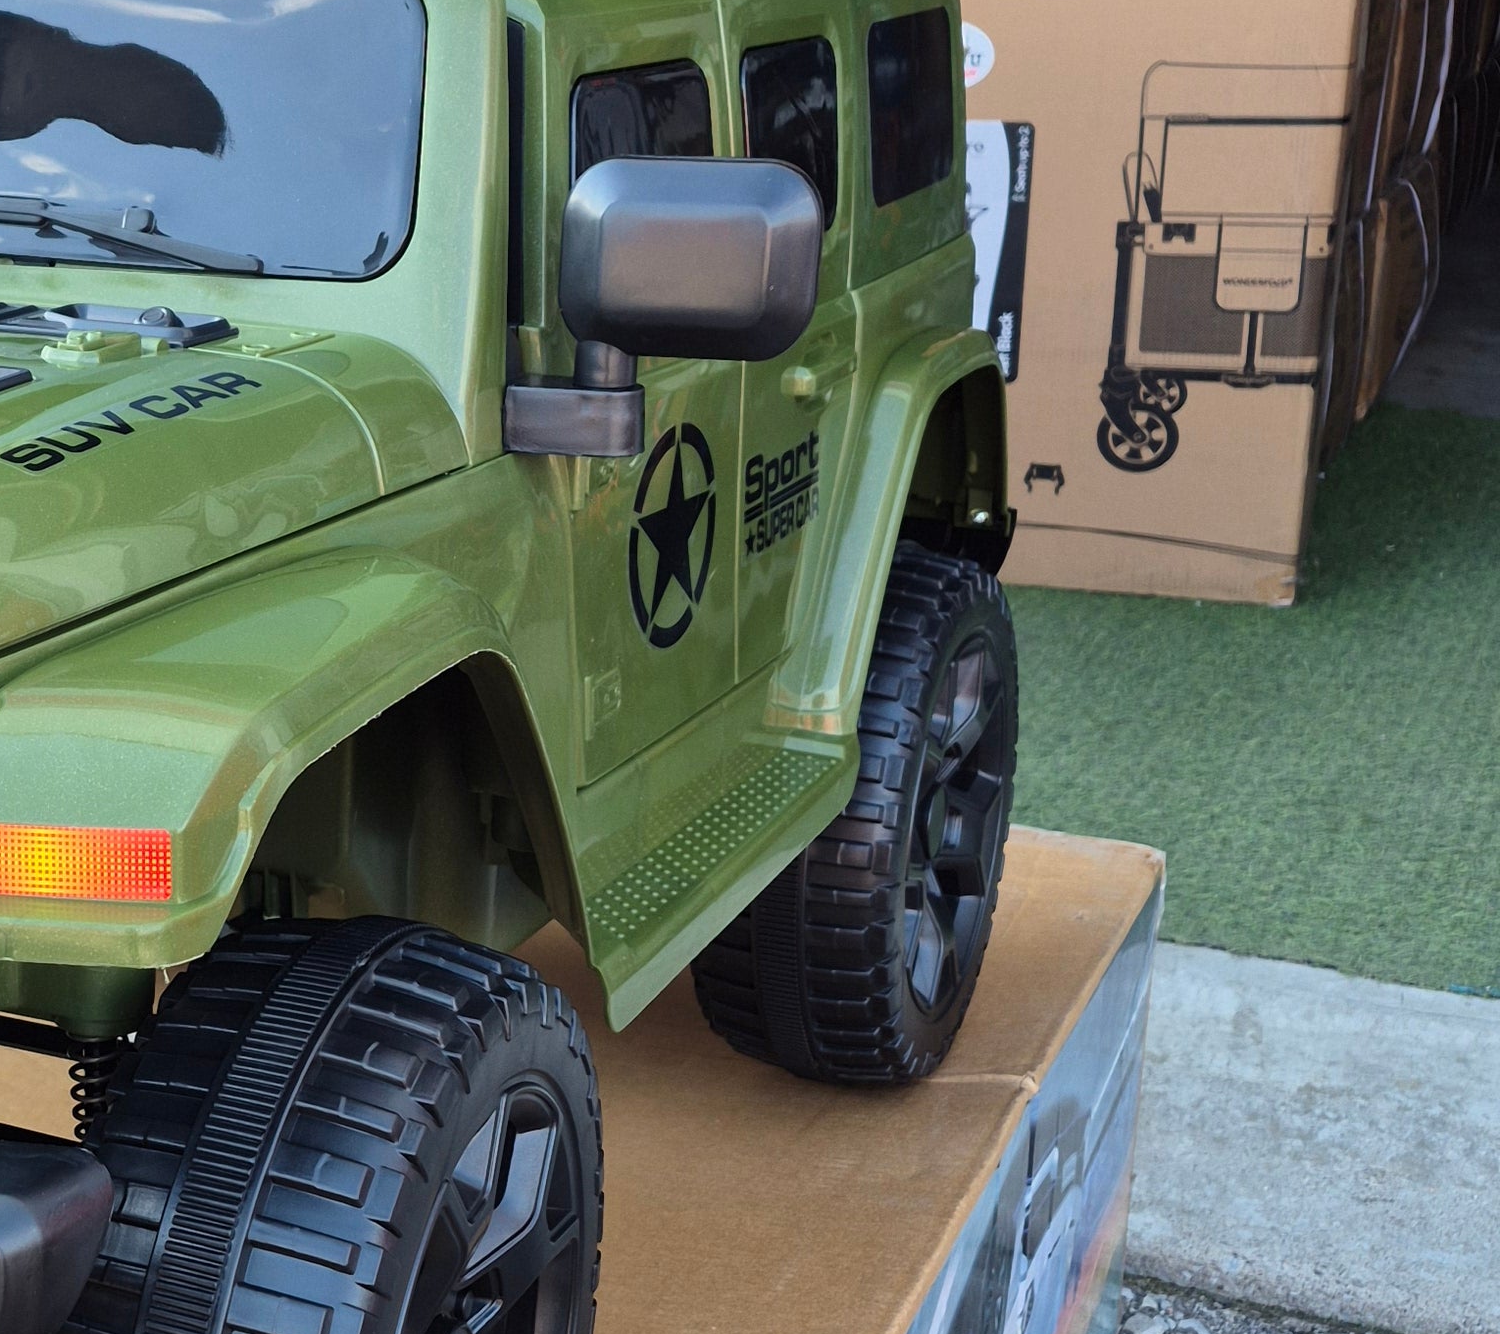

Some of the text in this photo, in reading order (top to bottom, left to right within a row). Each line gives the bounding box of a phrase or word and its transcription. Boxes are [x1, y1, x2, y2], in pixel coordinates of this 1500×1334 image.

[0, 371, 263, 472] SUV CAR
[744, 429, 820, 513] Sport
[755, 486, 820, 553] SUPER CAR
